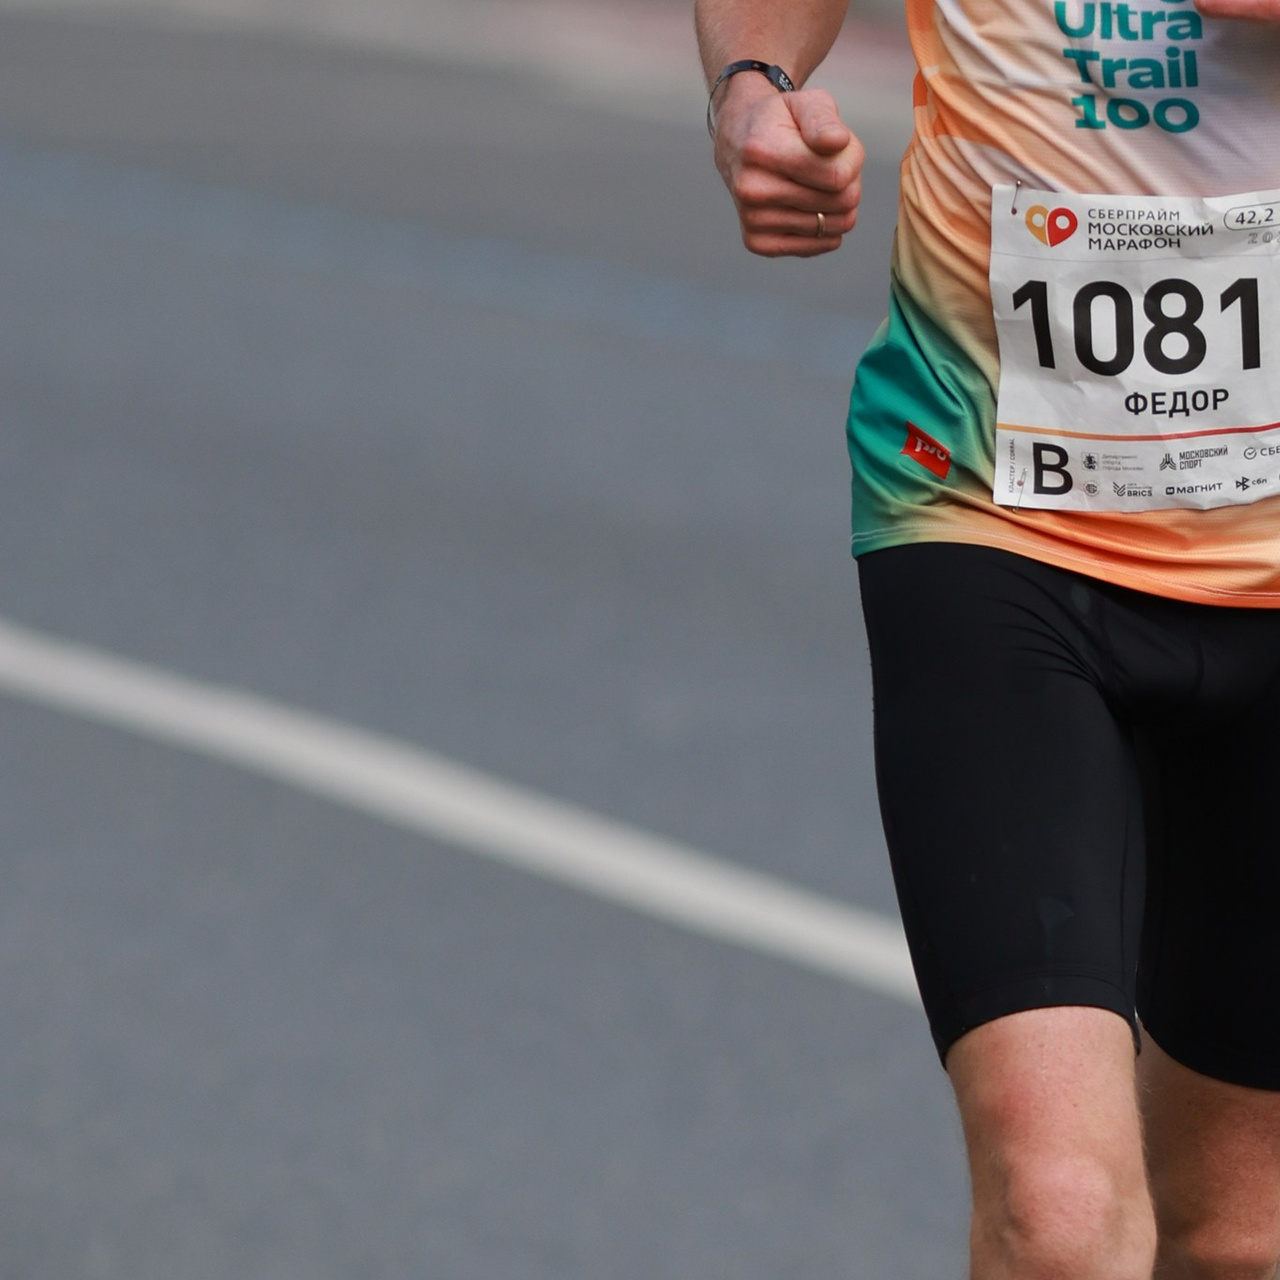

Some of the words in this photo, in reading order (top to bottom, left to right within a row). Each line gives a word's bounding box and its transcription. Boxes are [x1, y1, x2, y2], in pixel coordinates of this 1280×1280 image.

[1054, 1, 1203, 41] Ultra
[1063, 46, 1199, 89] Trail
[1071, 94, 1200, 134] 100
[1087, 208, 1181, 222] СБЕРПРАЙМ
[1235, 207, 1274, 226] 42,2
[1088, 222, 1214, 237] МОСКОВСКИЙ
[1088, 237, 1182, 251] МАРАФОН
[1125, 388, 1230, 418] ФЕДОР
[1179, 445, 1229, 460] МОСКОВСКИЙ
[1179, 459, 1202, 470] СПОРТ
